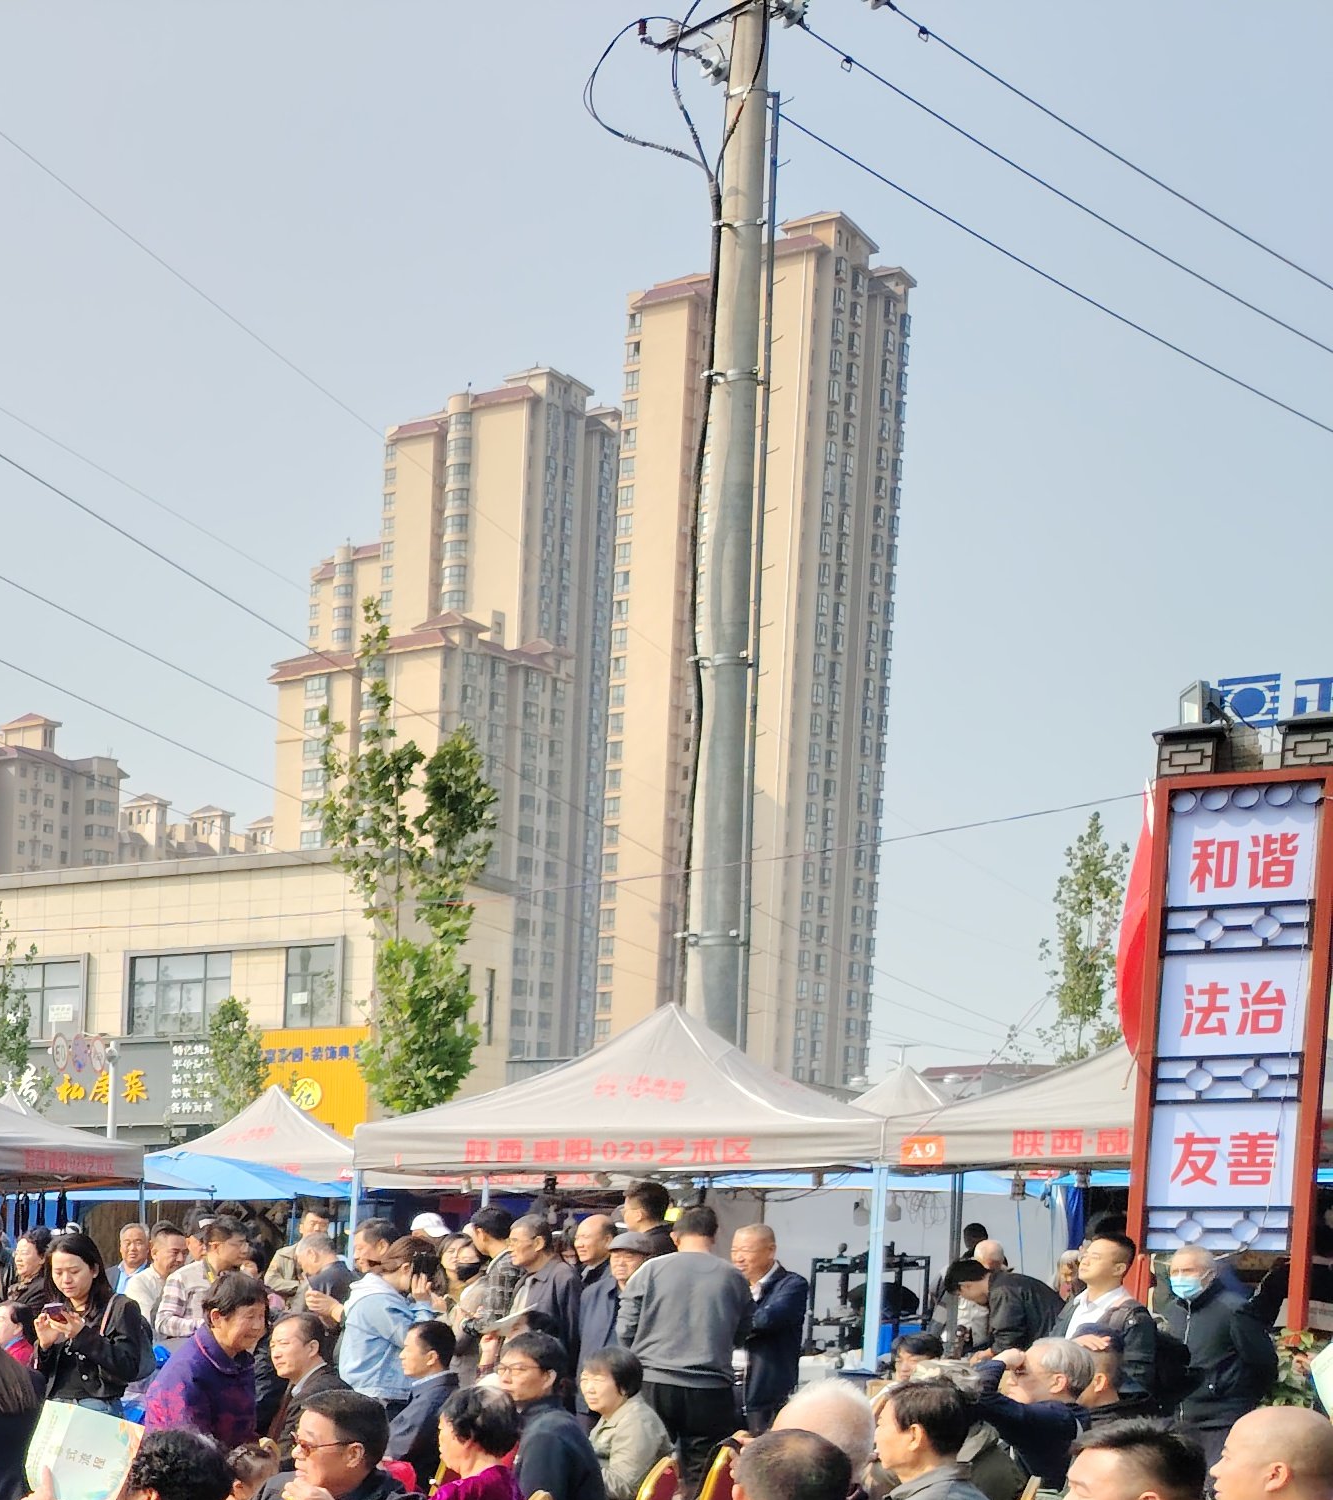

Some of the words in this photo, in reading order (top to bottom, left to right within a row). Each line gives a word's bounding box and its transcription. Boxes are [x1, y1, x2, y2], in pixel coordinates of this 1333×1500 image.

[1189, 832, 1299, 893] 和谐
[1180, 981, 1287, 1037] 法治
[56, 1069, 149, 1105] 私房菜
[908, 1143, 937, 1159] A9
[1170, 1131, 1279, 1187] 友善
